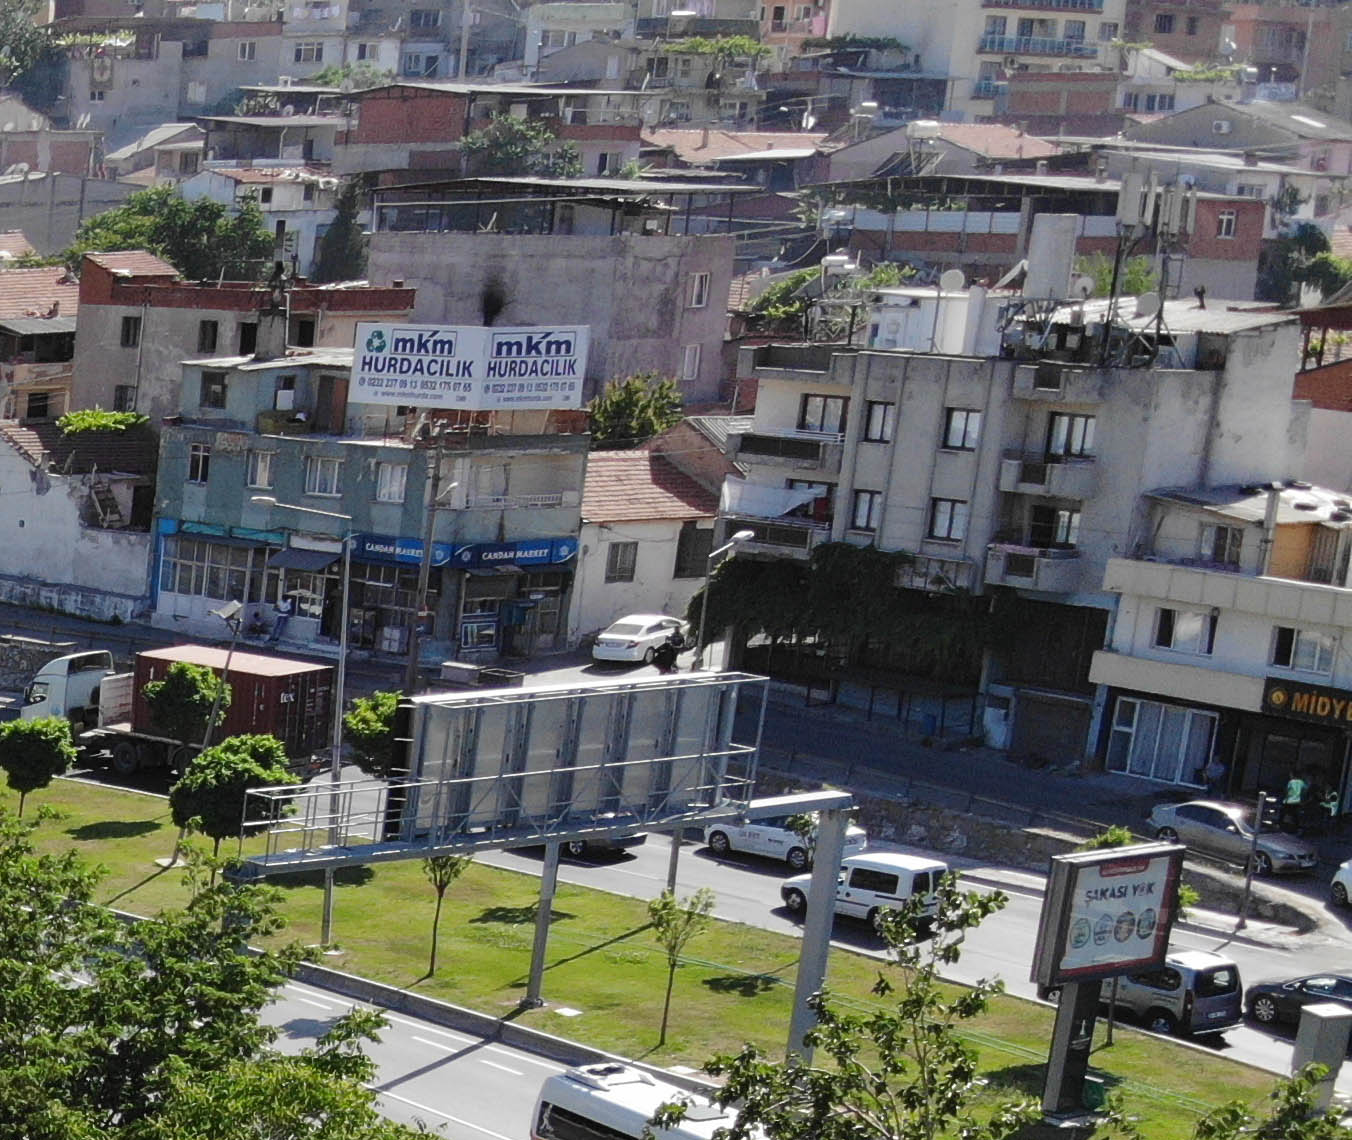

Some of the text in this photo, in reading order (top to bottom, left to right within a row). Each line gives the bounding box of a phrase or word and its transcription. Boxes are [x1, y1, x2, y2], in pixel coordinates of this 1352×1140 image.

[360, 355, 474, 378] HURDACILIK
[486, 358, 577, 378] HURDACILIK
[515, 548, 549, 560] MARKET
